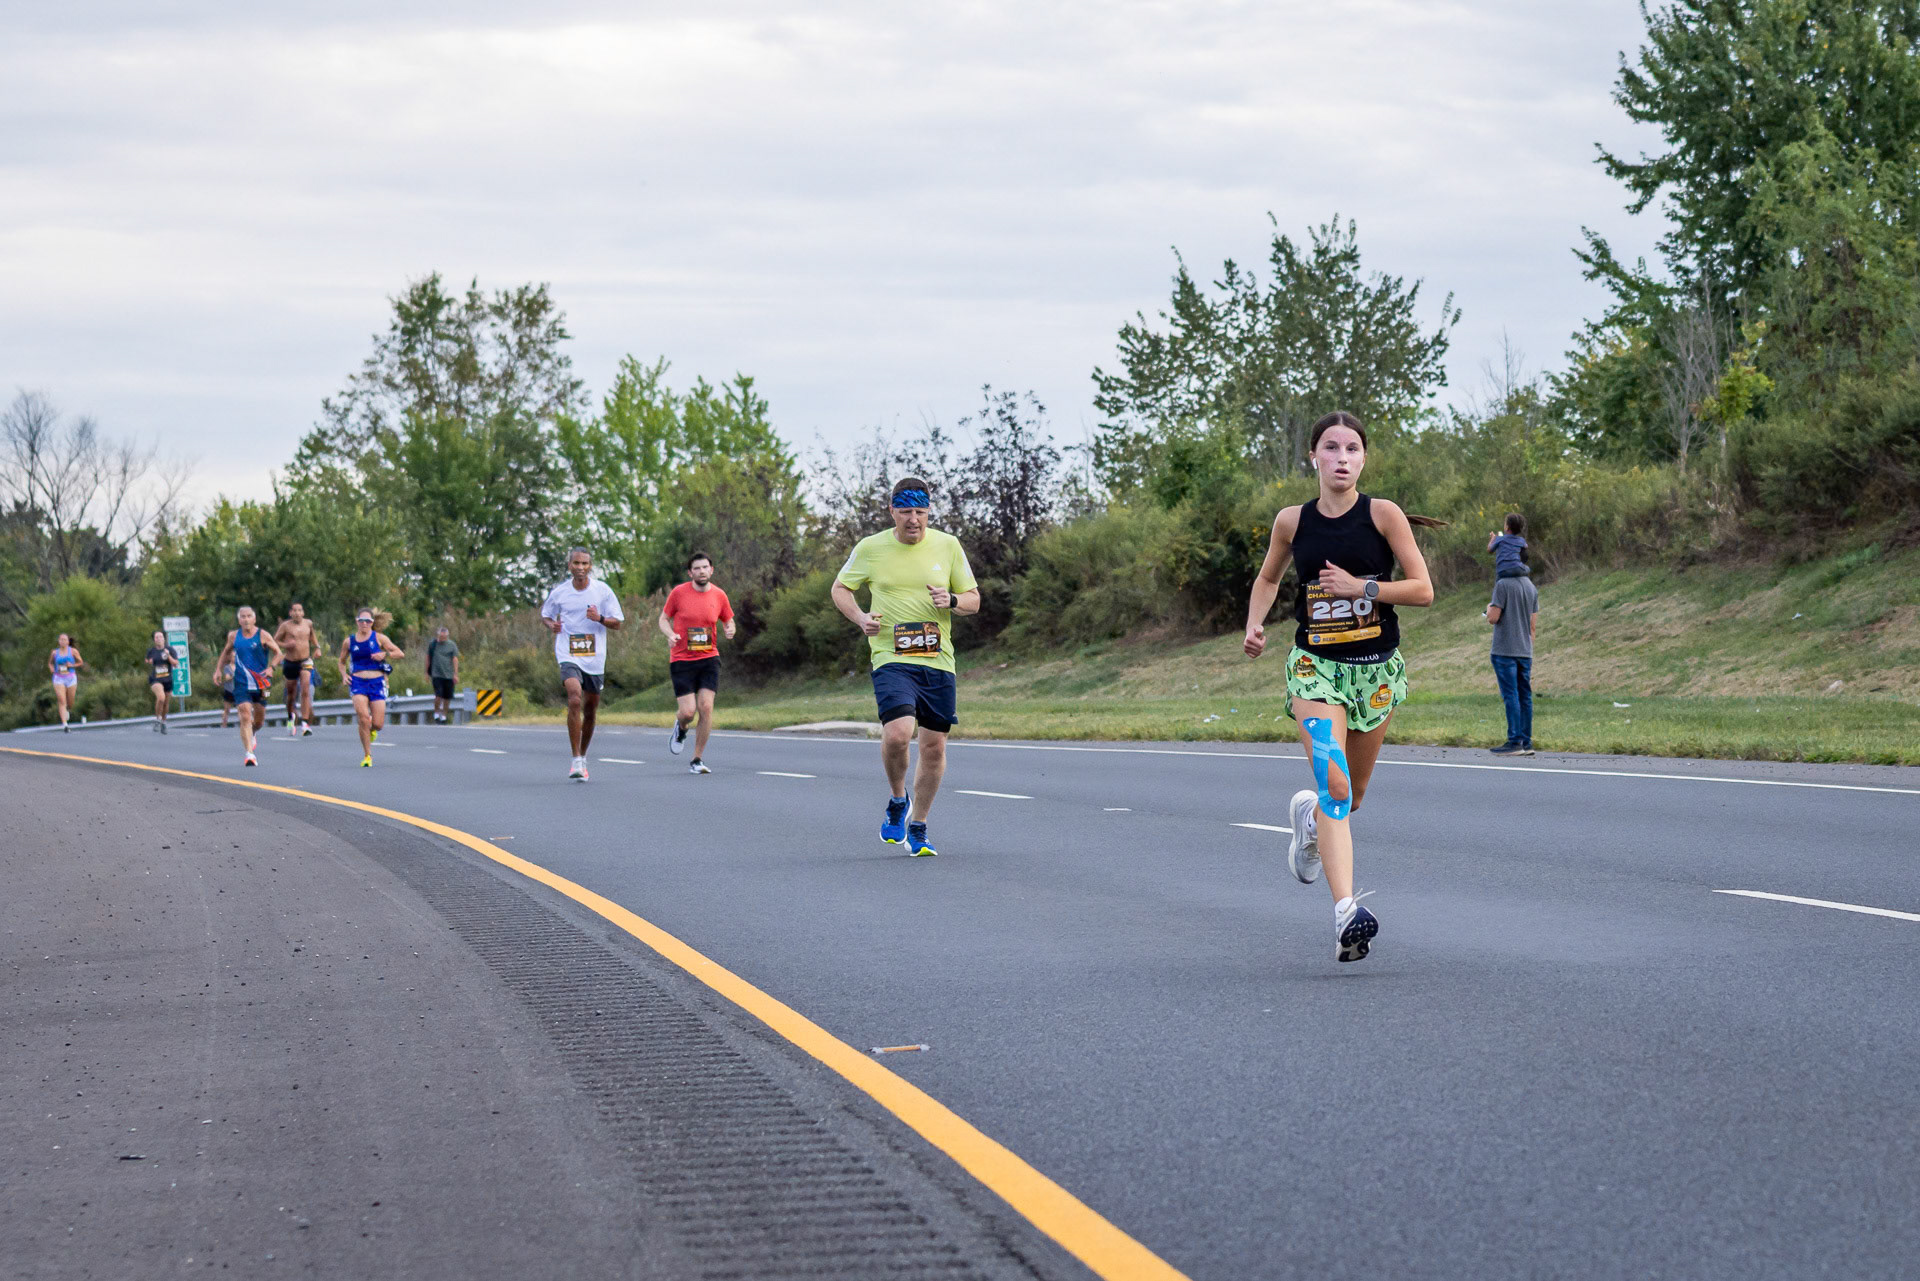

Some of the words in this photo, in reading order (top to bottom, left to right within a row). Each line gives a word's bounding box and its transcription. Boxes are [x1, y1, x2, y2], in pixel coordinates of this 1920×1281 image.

[1312, 599, 1373, 620] 220
[572, 641, 592, 649] 147
[898, 634, 938, 648] 345
[177, 670, 183, 681] 2
